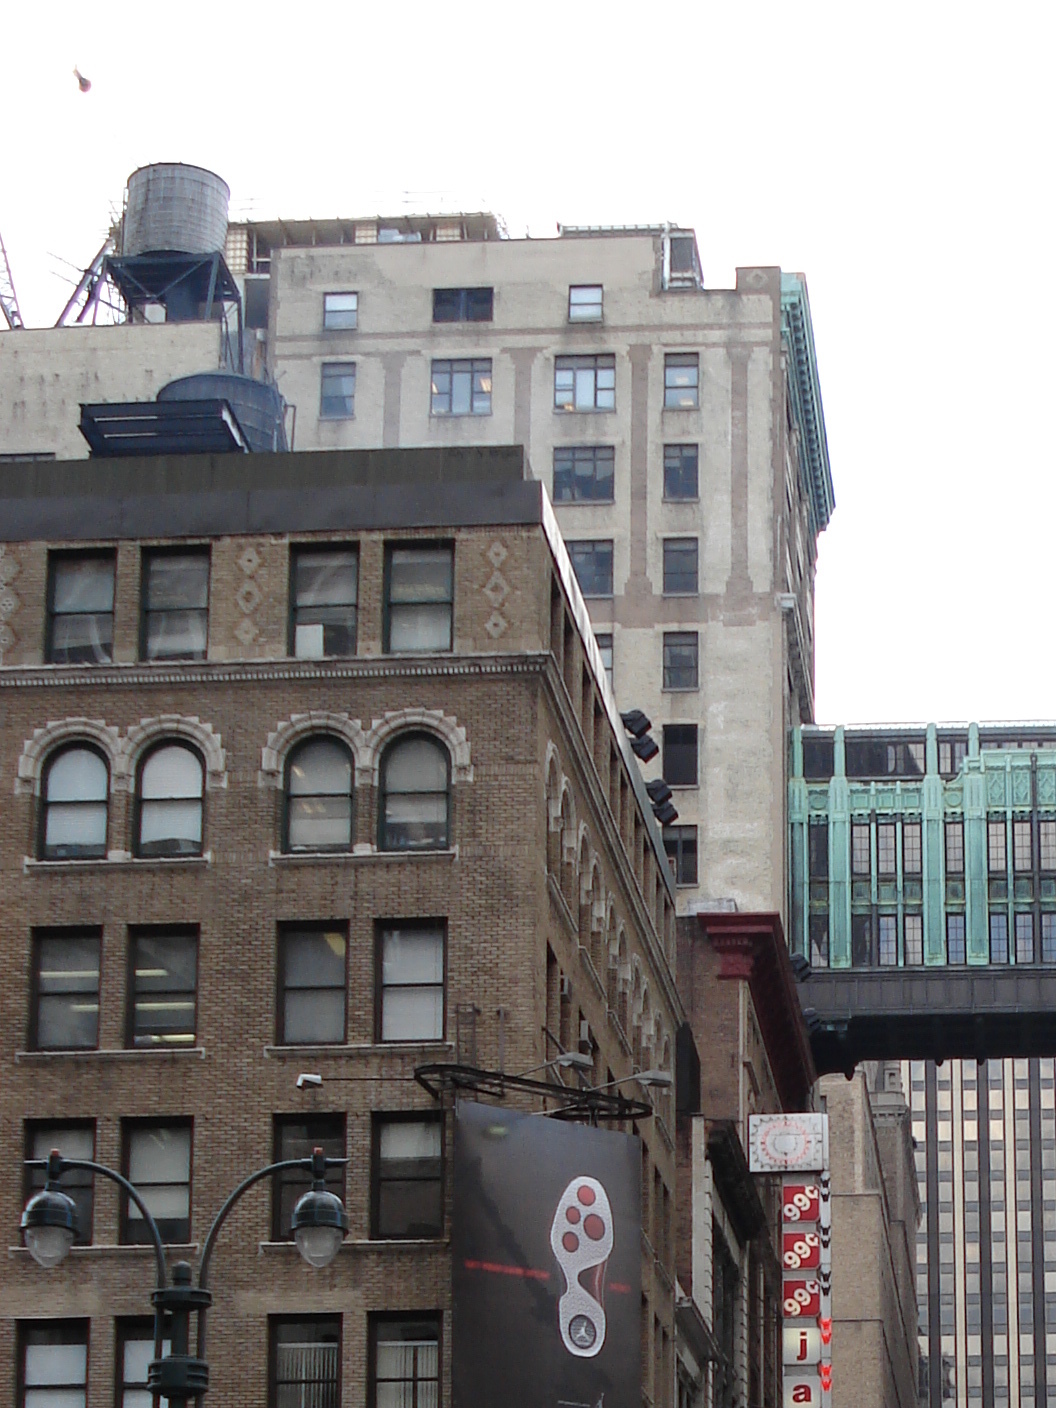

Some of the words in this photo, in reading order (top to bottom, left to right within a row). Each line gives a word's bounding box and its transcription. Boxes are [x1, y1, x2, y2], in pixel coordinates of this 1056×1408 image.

[784, 1185, 819, 1220] 99¢
[784, 1233, 819, 1269] 99¢
[784, 1280, 819, 1316] 99¢
